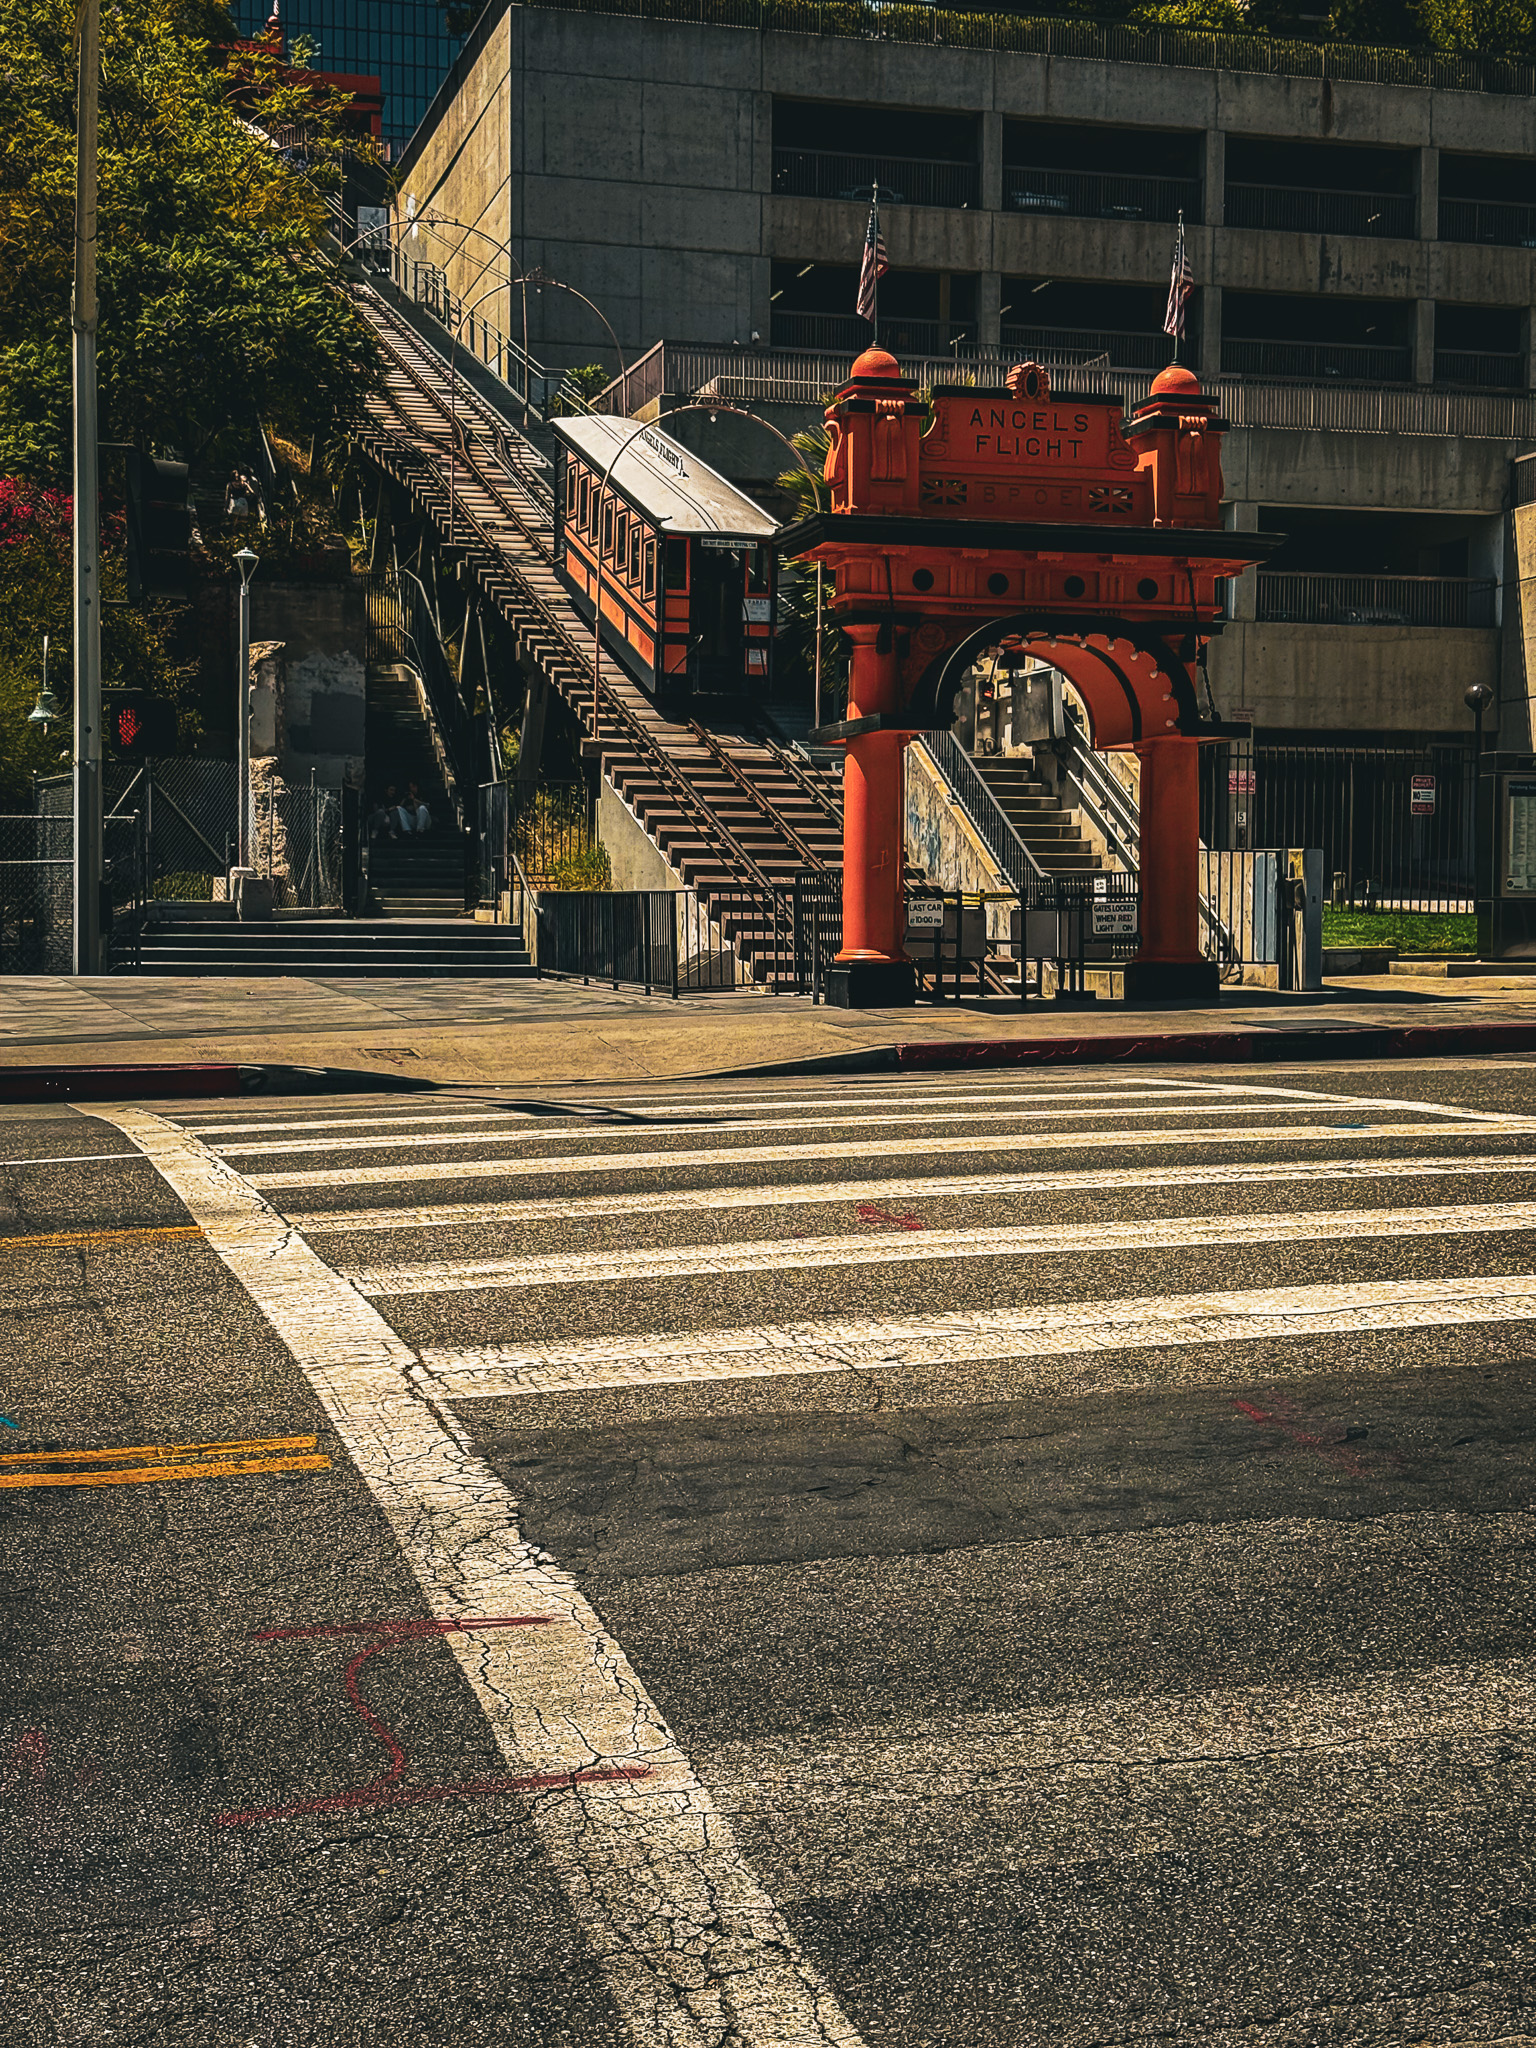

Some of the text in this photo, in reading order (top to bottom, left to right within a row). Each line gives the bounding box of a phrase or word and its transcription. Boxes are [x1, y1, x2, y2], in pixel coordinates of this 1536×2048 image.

[969, 408, 1089, 433] ANGELS
[976, 434, 1083, 458] FLIGHT
[1238, 812, 1244, 821] 5
[1096, 914, 1132, 922] WHEN RED
[1096, 924, 1114, 932] LIGHT
